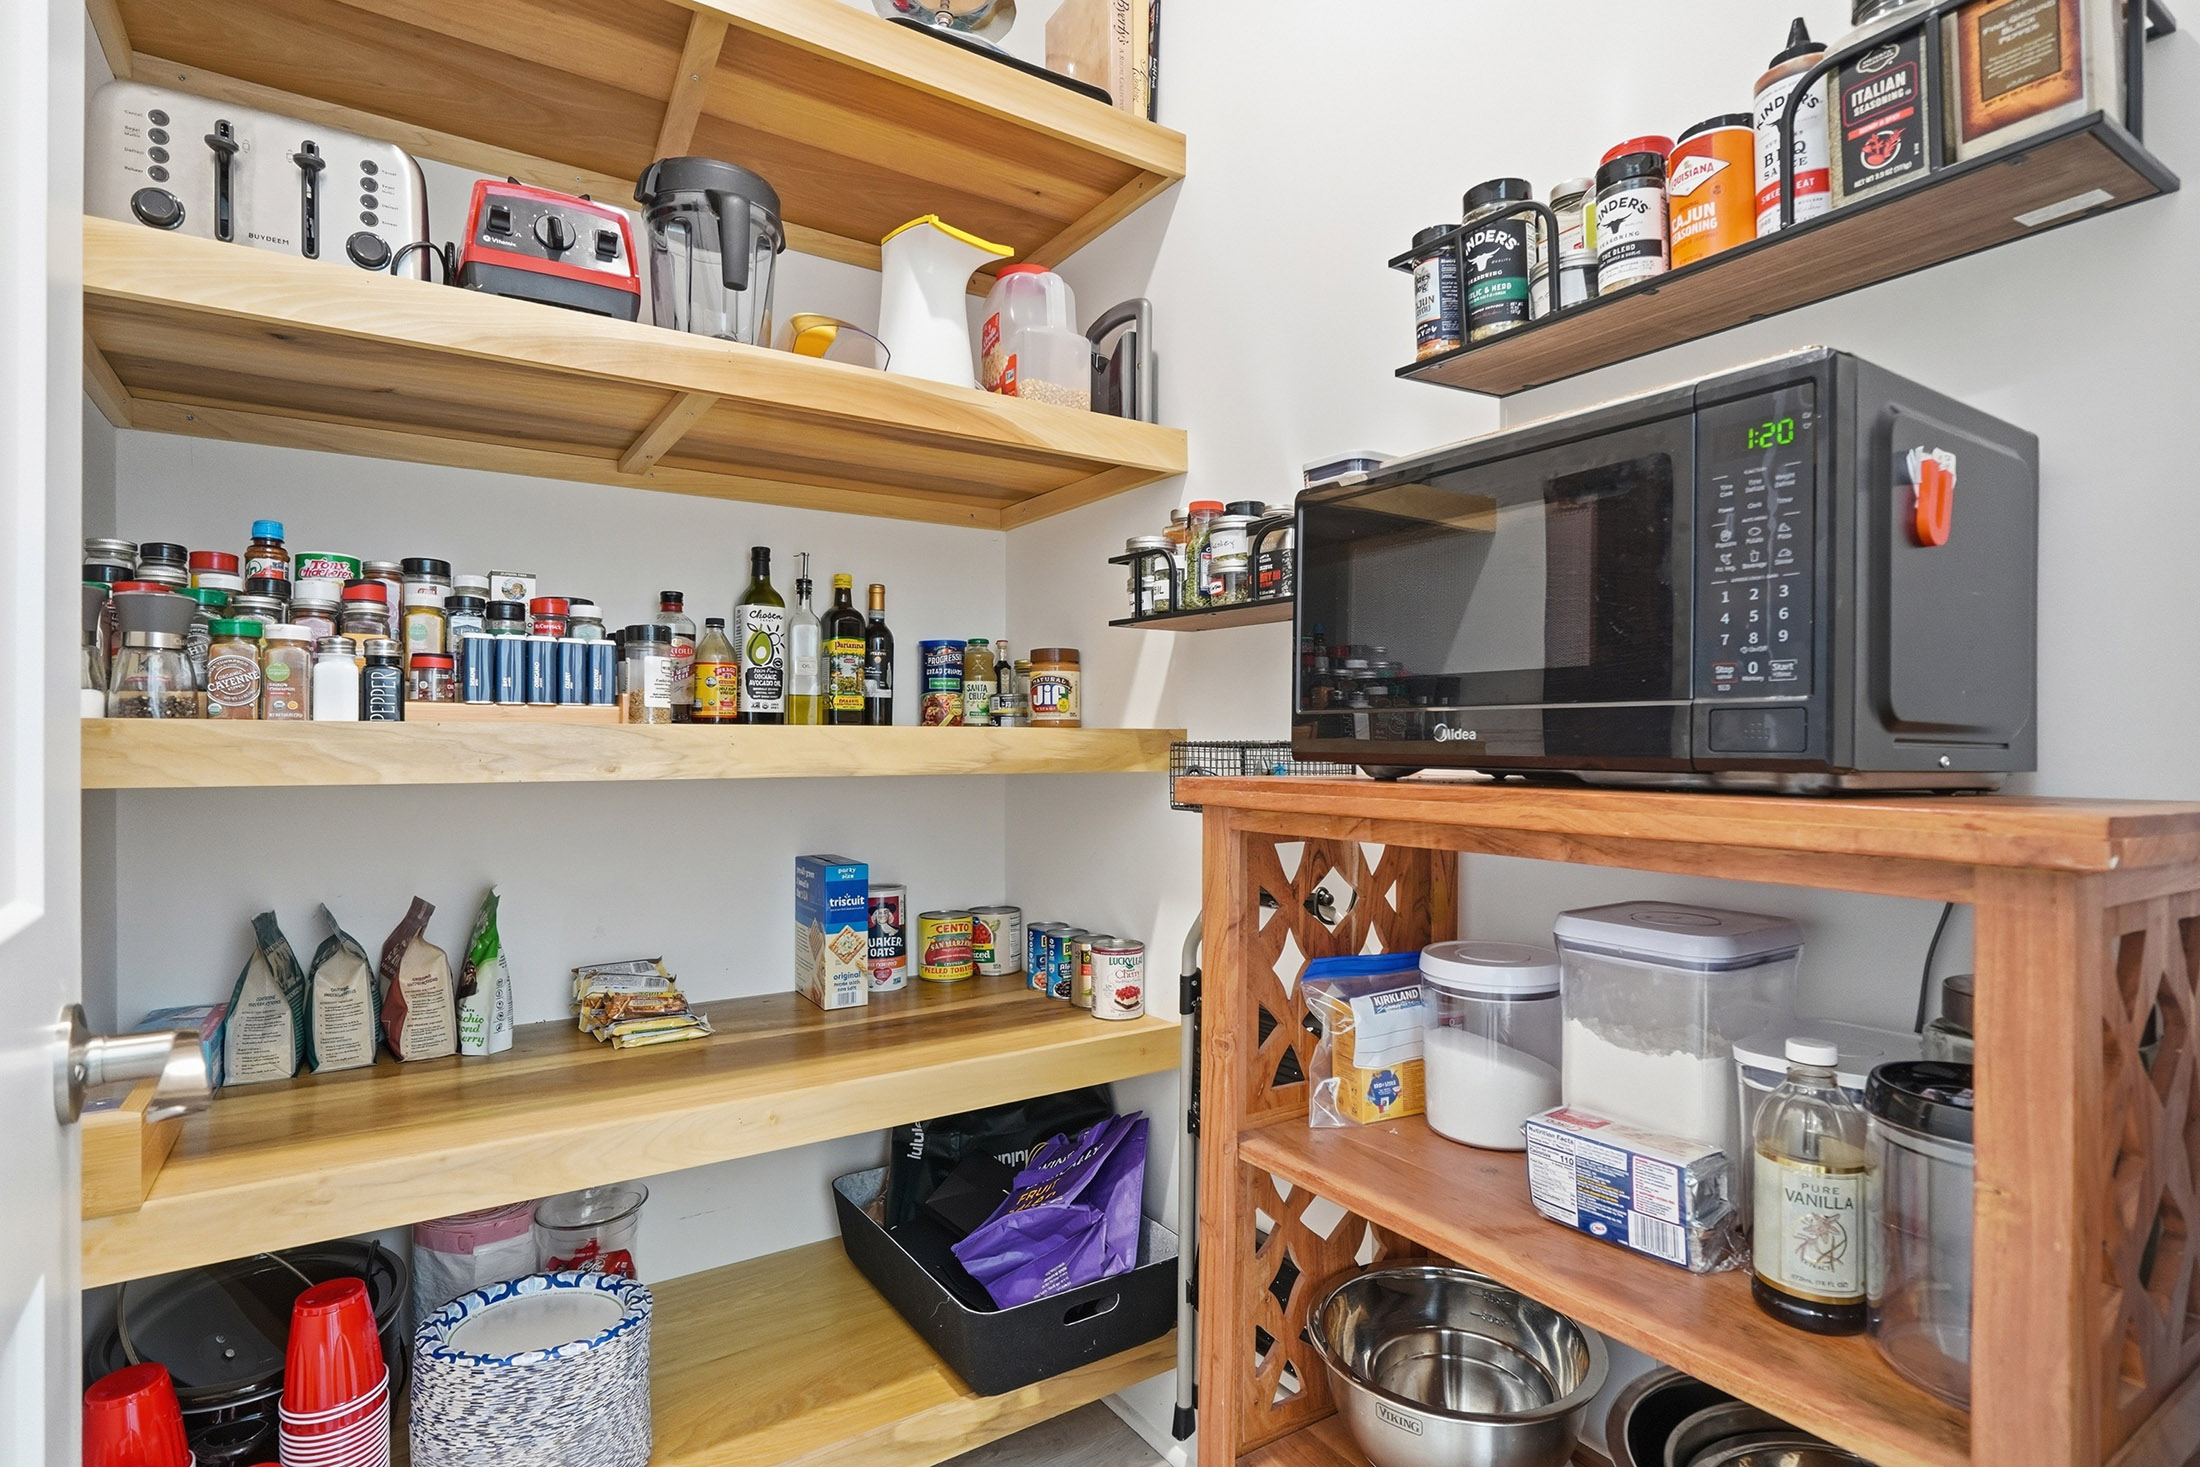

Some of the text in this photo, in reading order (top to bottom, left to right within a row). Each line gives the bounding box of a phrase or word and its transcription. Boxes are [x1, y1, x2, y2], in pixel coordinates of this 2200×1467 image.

[2001, 15, 2036, 35] BLACK
[1998, 23, 2040, 45] PEPPER
[1851, 70, 1906, 108] ITALIAN
[1853, 88, 1904, 117] SEASONING
[1761, 188, 1782, 205] SWEE
[1672, 201, 1716, 233] CAJUN
[1671, 217, 1718, 246] SEASONING
[248, 232, 290, 246] BUYDEEM
[491, 236, 517, 248] Vitamix
[1612, 243, 1636, 256] BLEND
[1748, 418, 1794, 449] 1:20
[1721, 591, 1730, 603] 1
[1749, 588, 1759, 600] 2
[1779, 585, 1789, 598] 3
[749, 609, 783, 620] Chosen
[1720, 613, 1730, 624] 4
[1749, 610, 1759, 622] 5
[1779, 607, 1789, 620] 6
[1720, 634, 1730, 646] 7
[1748, 632, 1759, 644] 8
[1778, 629, 1789, 642] 9
[1715, 666, 1735, 674] Stop
[1748, 661, 1759, 675] 0
[1772, 662, 1794, 671] Start
[207, 671, 260, 692] CAYENNE
[1033, 676, 1067, 684] NATURAL
[966, 684, 988, 692] SANTA
[370, 670, 396, 721] PEPPER
[1033, 685, 1066, 705] Jif
[1442, 726, 1477, 741] Midea
[838, 867, 856, 875] party
[829, 897, 865, 907] triscuit
[935, 923, 970, 934] CENTO
[868, 937, 903, 949] UAKER
[931, 941, 945, 951] SAN
[870, 947, 895, 958] OATS
[833, 971, 861, 981] original
[1373, 989, 1419, 1006] KIRKLAND
[1528, 1126, 1574, 1145] Nutrition Facts
[1560, 1155, 1574, 1166] 110
[1016, 1178, 1061, 1205] FRUIT
[1801, 1183, 1840, 1195] PURE
[1785, 1187, 1854, 1210] VANILLA
[1378, 1406, 1421, 1434] VIKING
